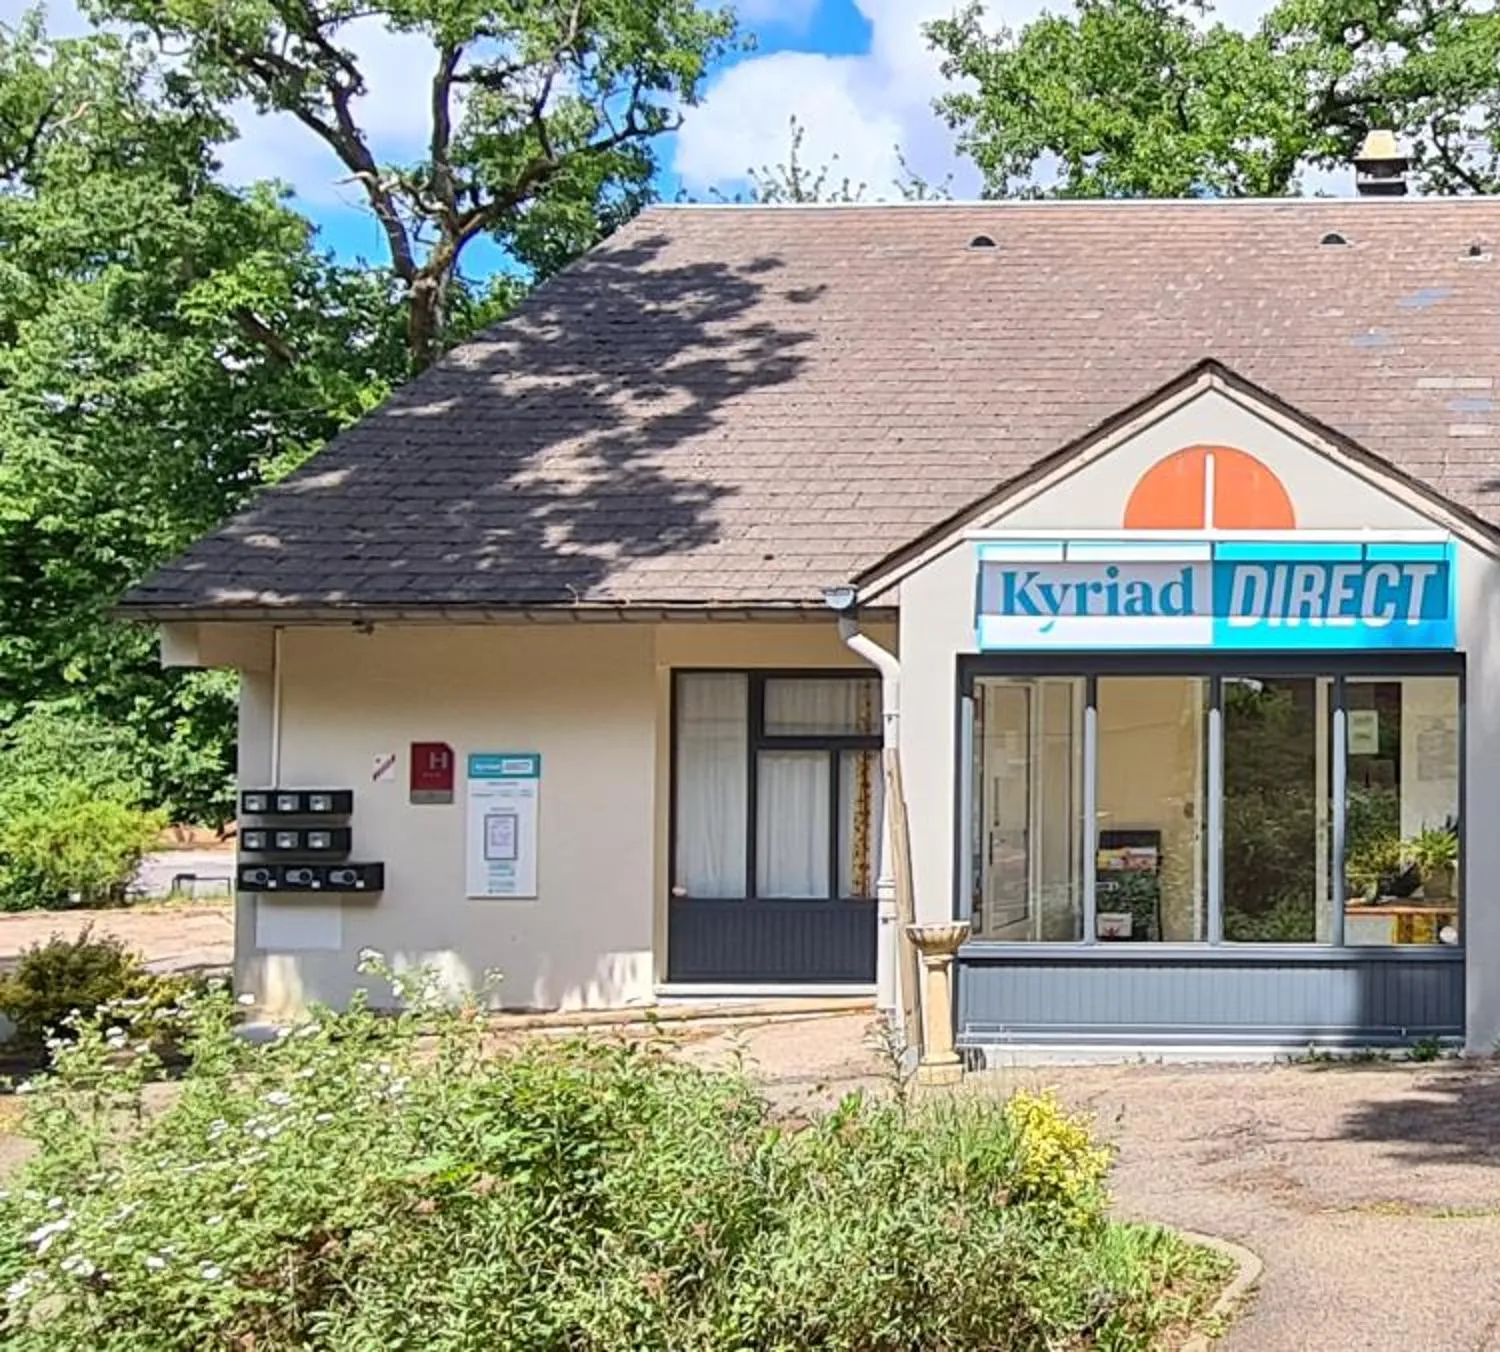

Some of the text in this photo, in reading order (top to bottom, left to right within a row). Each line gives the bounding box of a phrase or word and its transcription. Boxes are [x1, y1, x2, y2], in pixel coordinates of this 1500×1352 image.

[1001, 563, 1438, 632] Kyriad DIRECT
[430, 752, 448, 769] H
